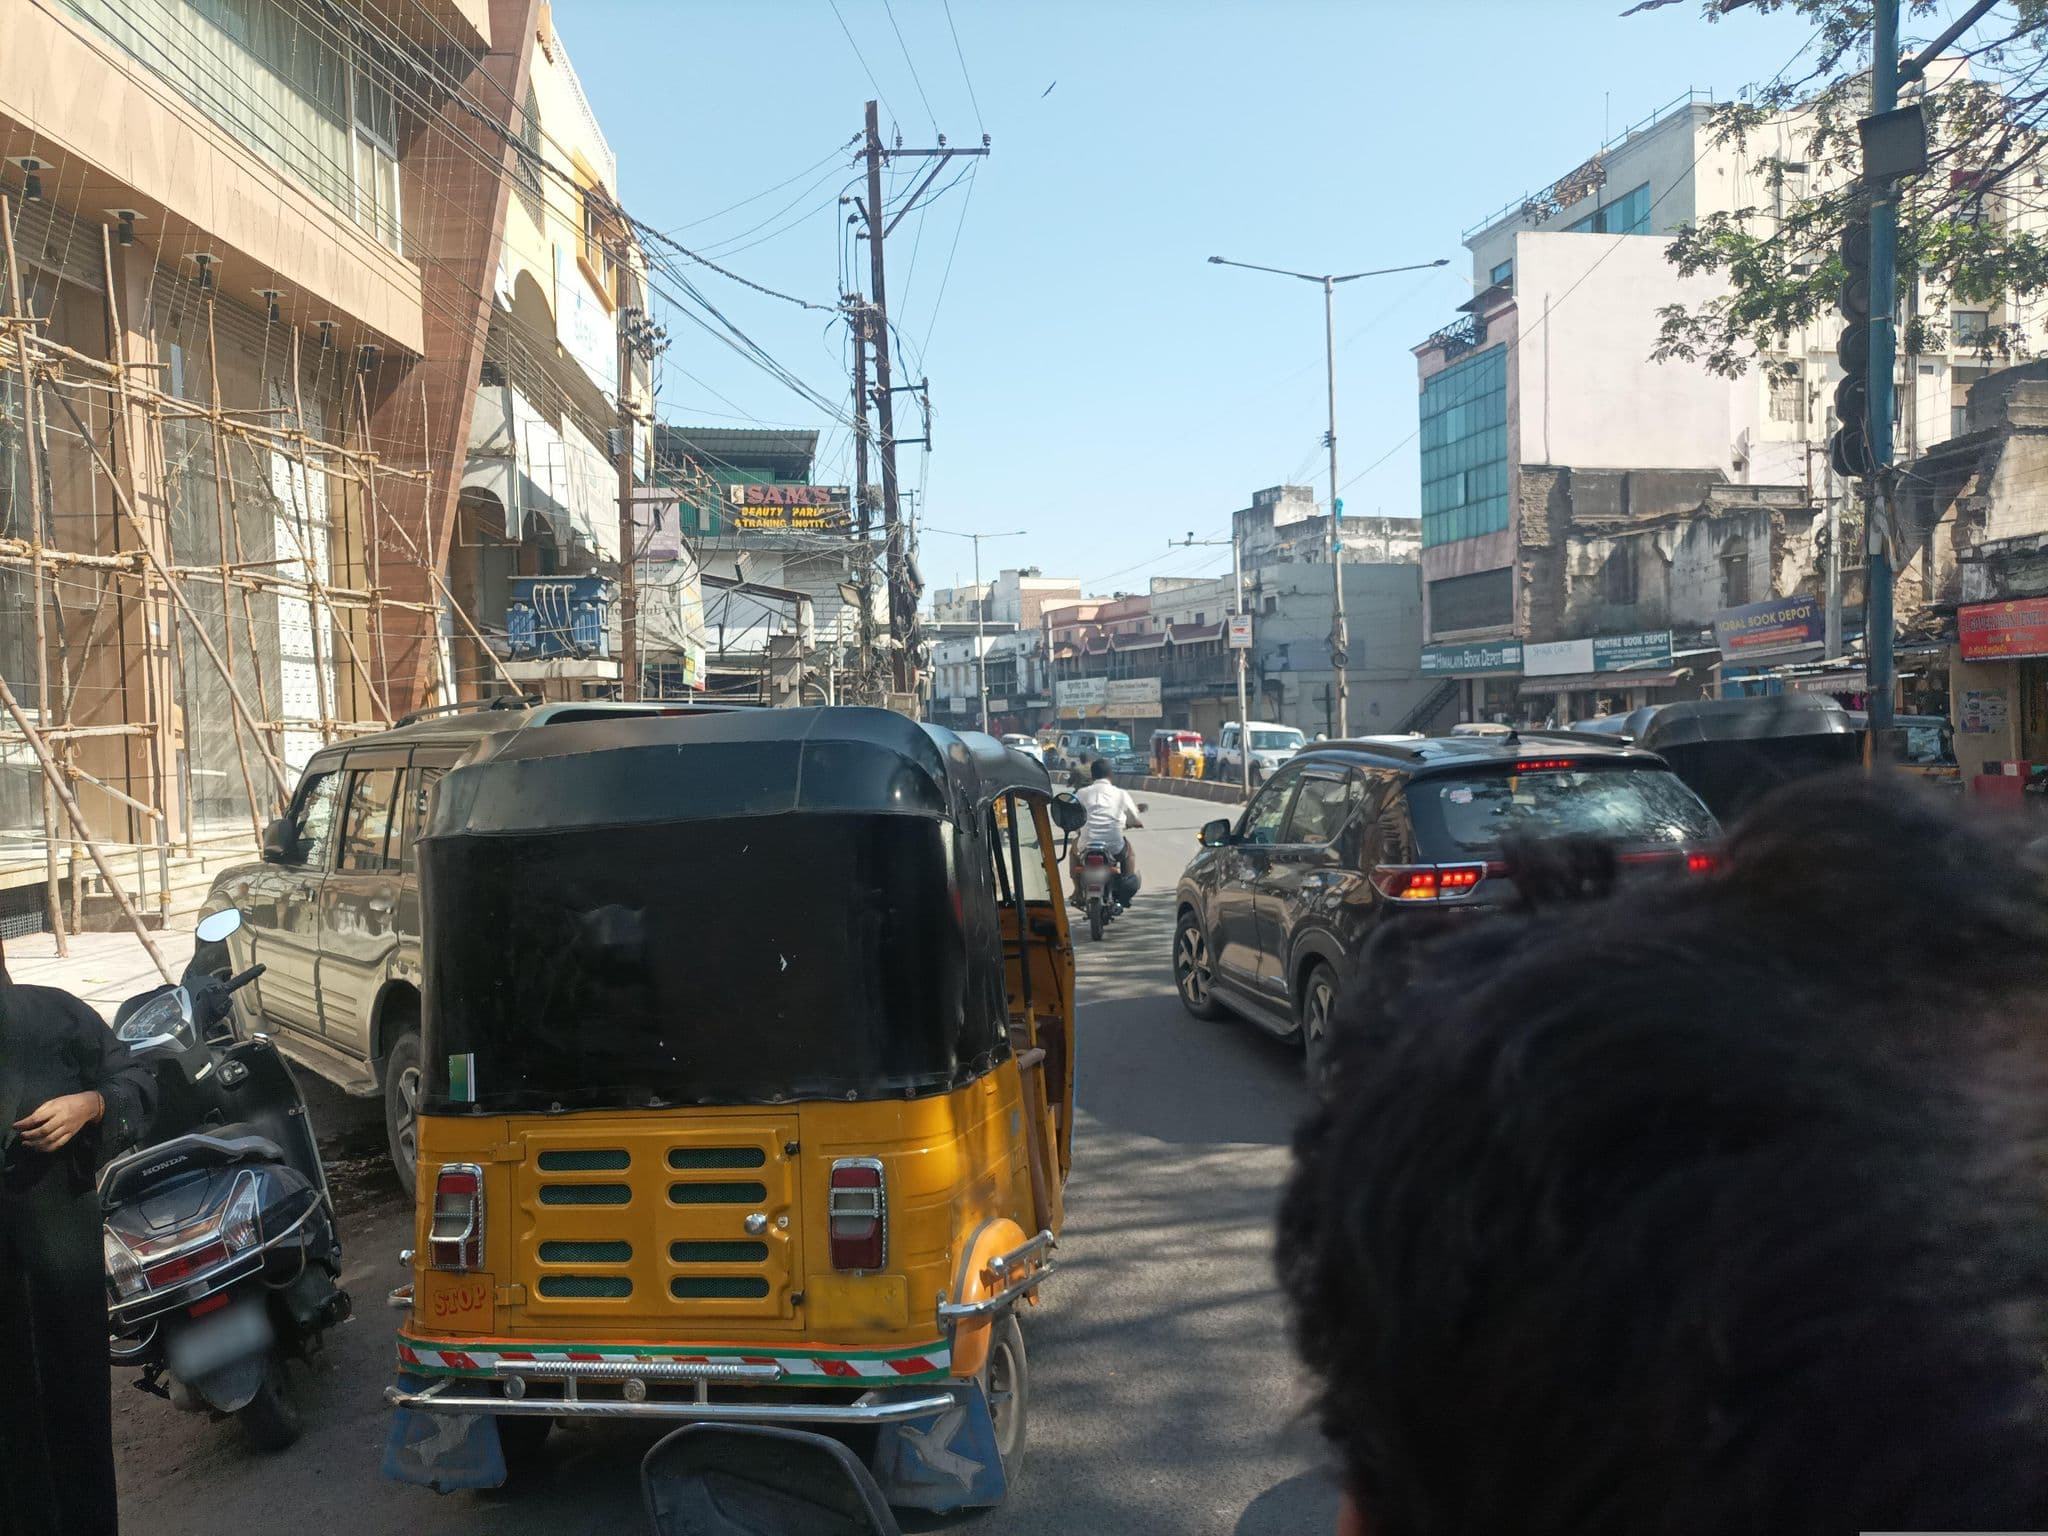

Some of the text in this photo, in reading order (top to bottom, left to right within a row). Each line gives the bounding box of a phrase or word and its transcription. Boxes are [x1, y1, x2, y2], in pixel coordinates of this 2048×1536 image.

[746, 484, 831, 504] SAM'S
[741, 506, 784, 517] BEAUTY
[1748, 613, 1777, 627] BOOK
[1778, 606, 1811, 621] DEPOT
[1623, 635, 1643, 647] BOOK
[1644, 634, 1668, 645] DEPOT
[142, 1155, 188, 1176] HONDA
[432, 1286, 487, 1317] STOP
